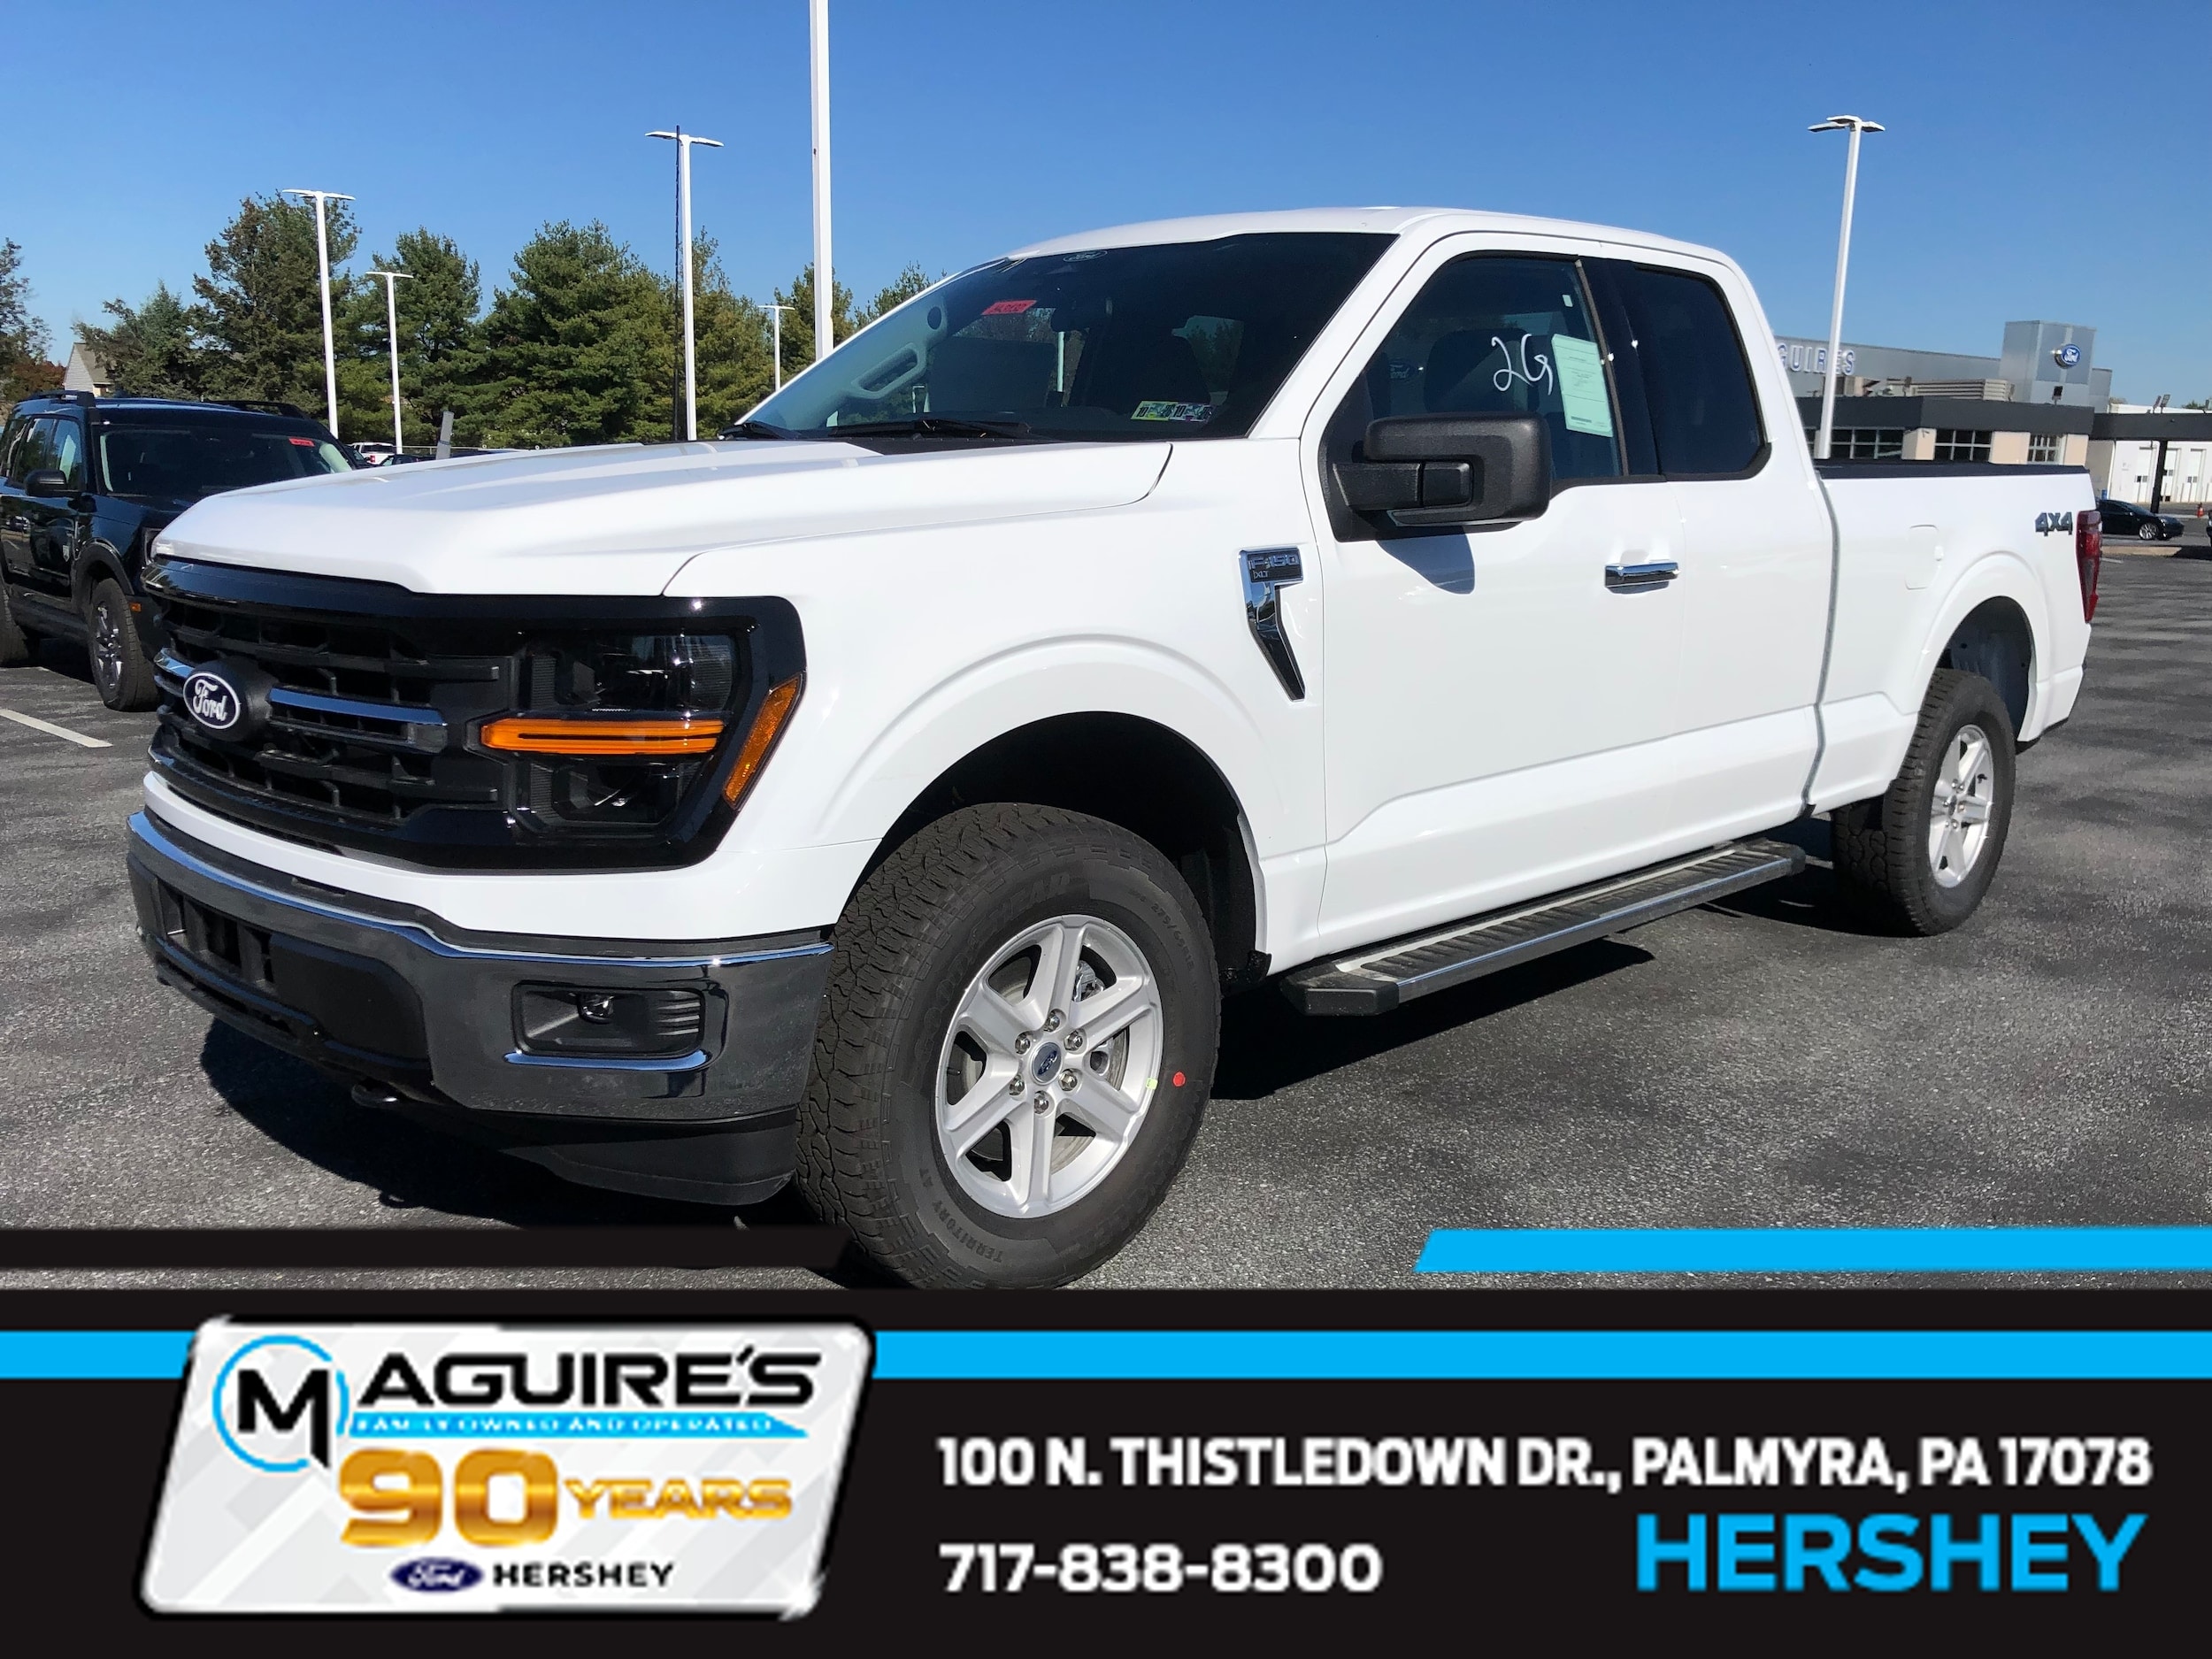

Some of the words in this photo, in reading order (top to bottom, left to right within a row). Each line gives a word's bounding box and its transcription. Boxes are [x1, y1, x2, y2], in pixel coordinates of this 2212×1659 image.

[1777, 342, 1856, 376] GUIRS
[192, 678, 228, 722] Ford
[932, 1199, 1004, 1263] TERRITORY
